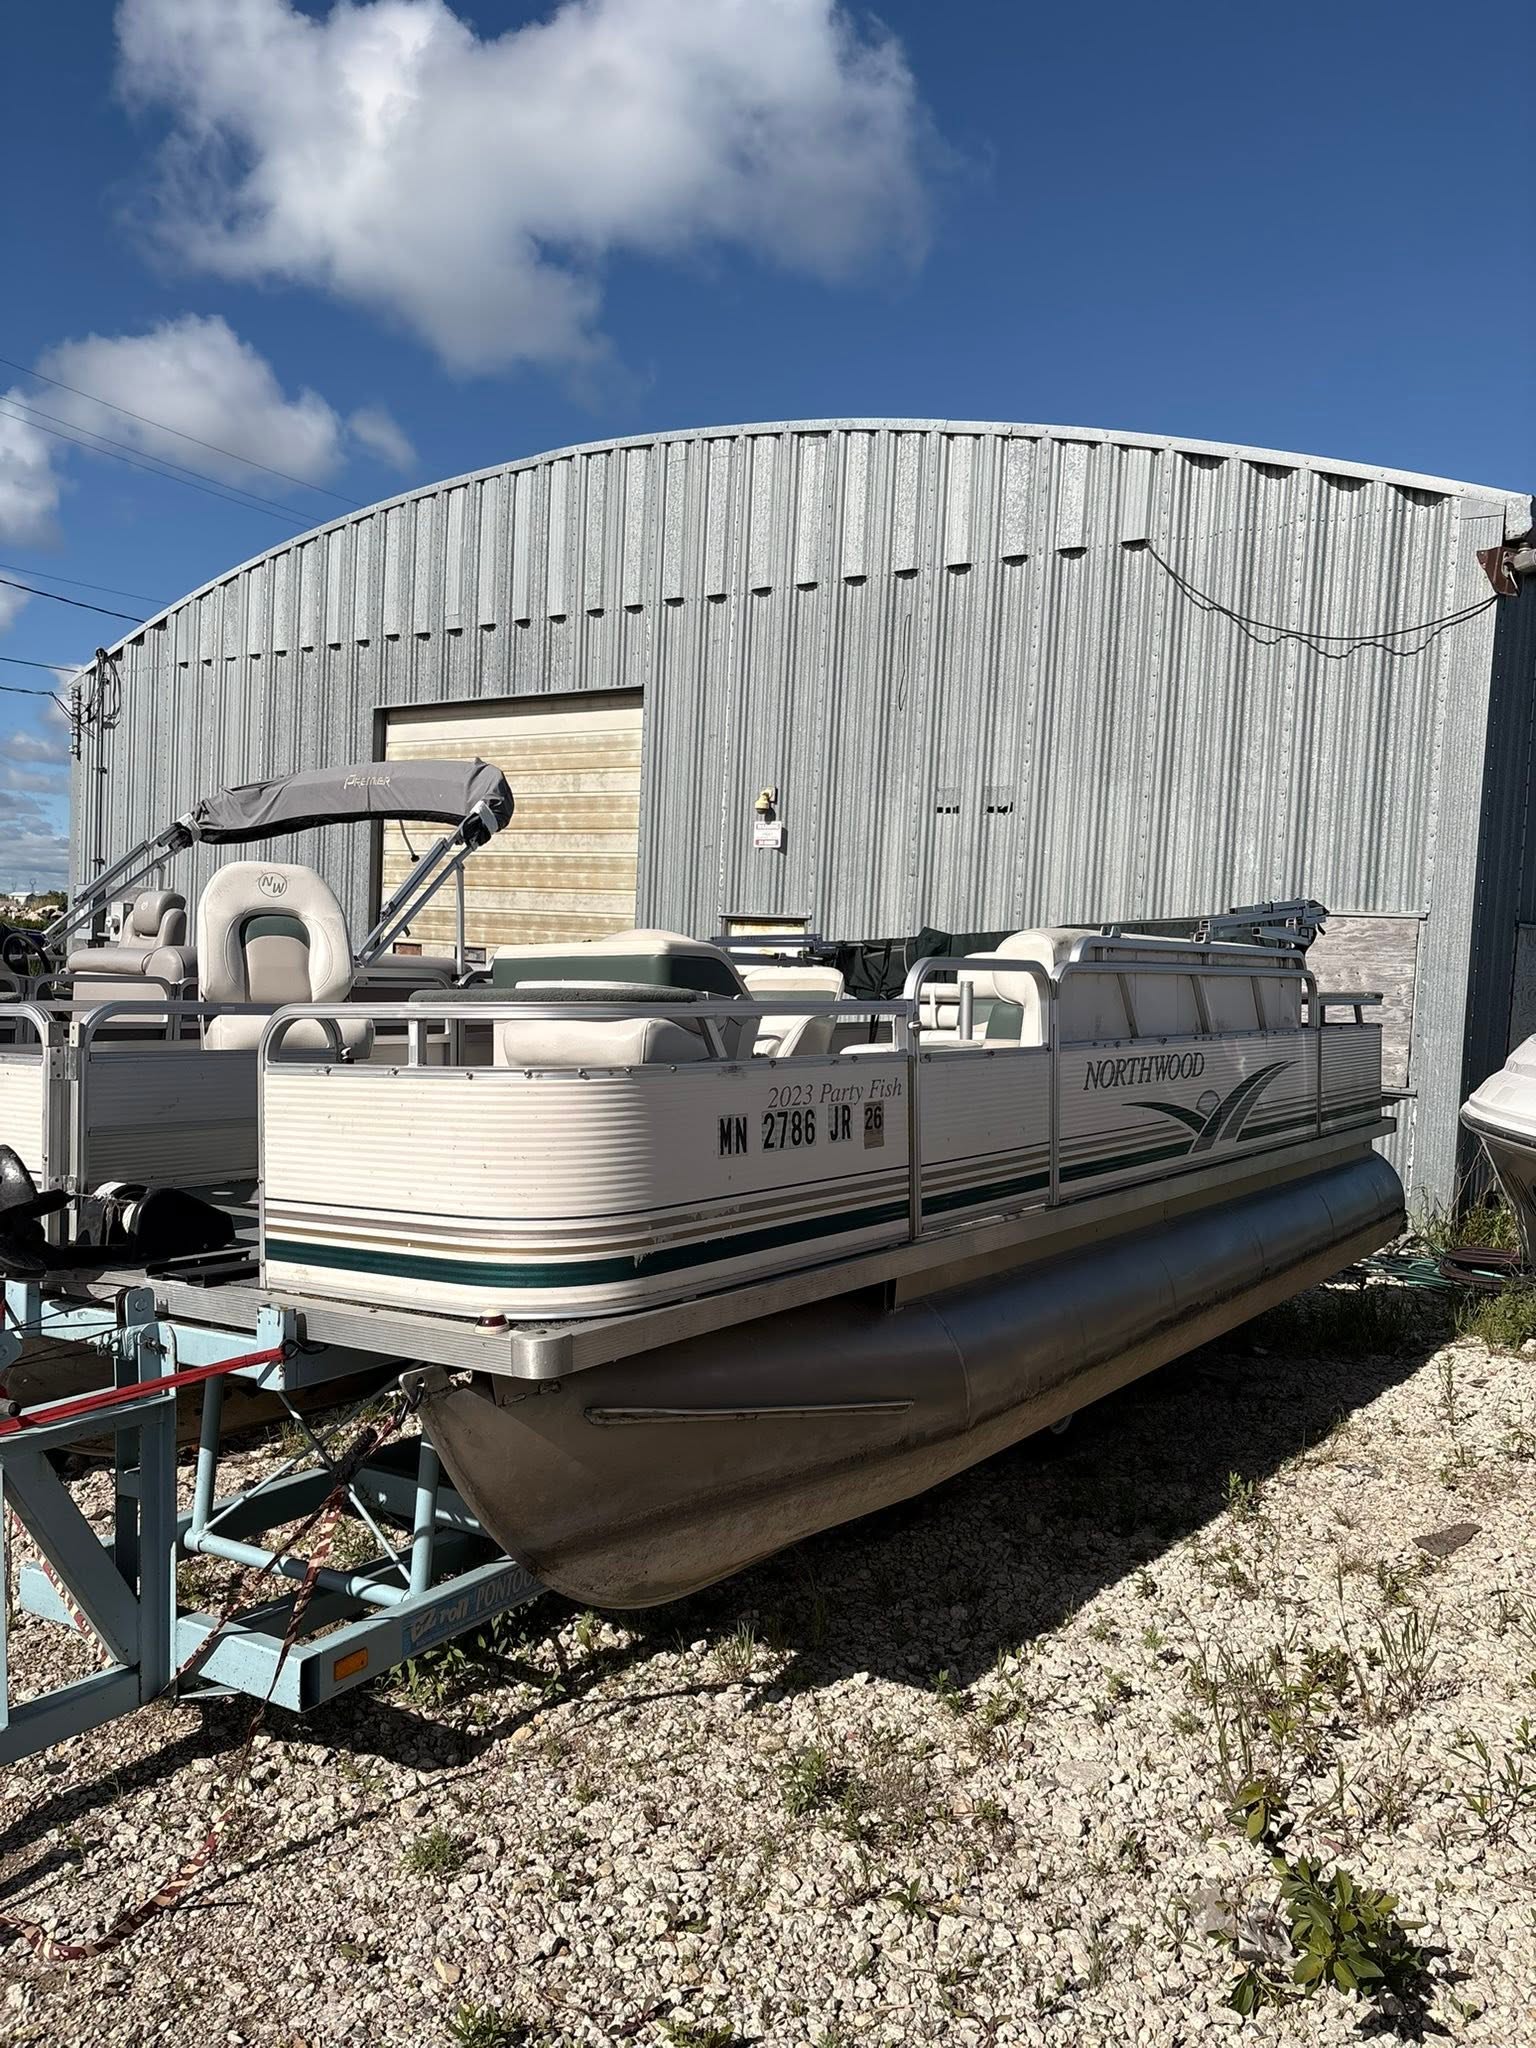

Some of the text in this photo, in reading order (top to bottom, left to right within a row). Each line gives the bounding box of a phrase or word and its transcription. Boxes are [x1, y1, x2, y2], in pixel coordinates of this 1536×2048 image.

[343, 774, 391, 789] PREMIER
[1082, 1052, 1205, 1091] NORTHWOOD
[767, 1077, 903, 1109] 2023 Party Fish
[719, 1104, 851, 1156] MN 2786 JR
[864, 1105, 882, 1130] 26
